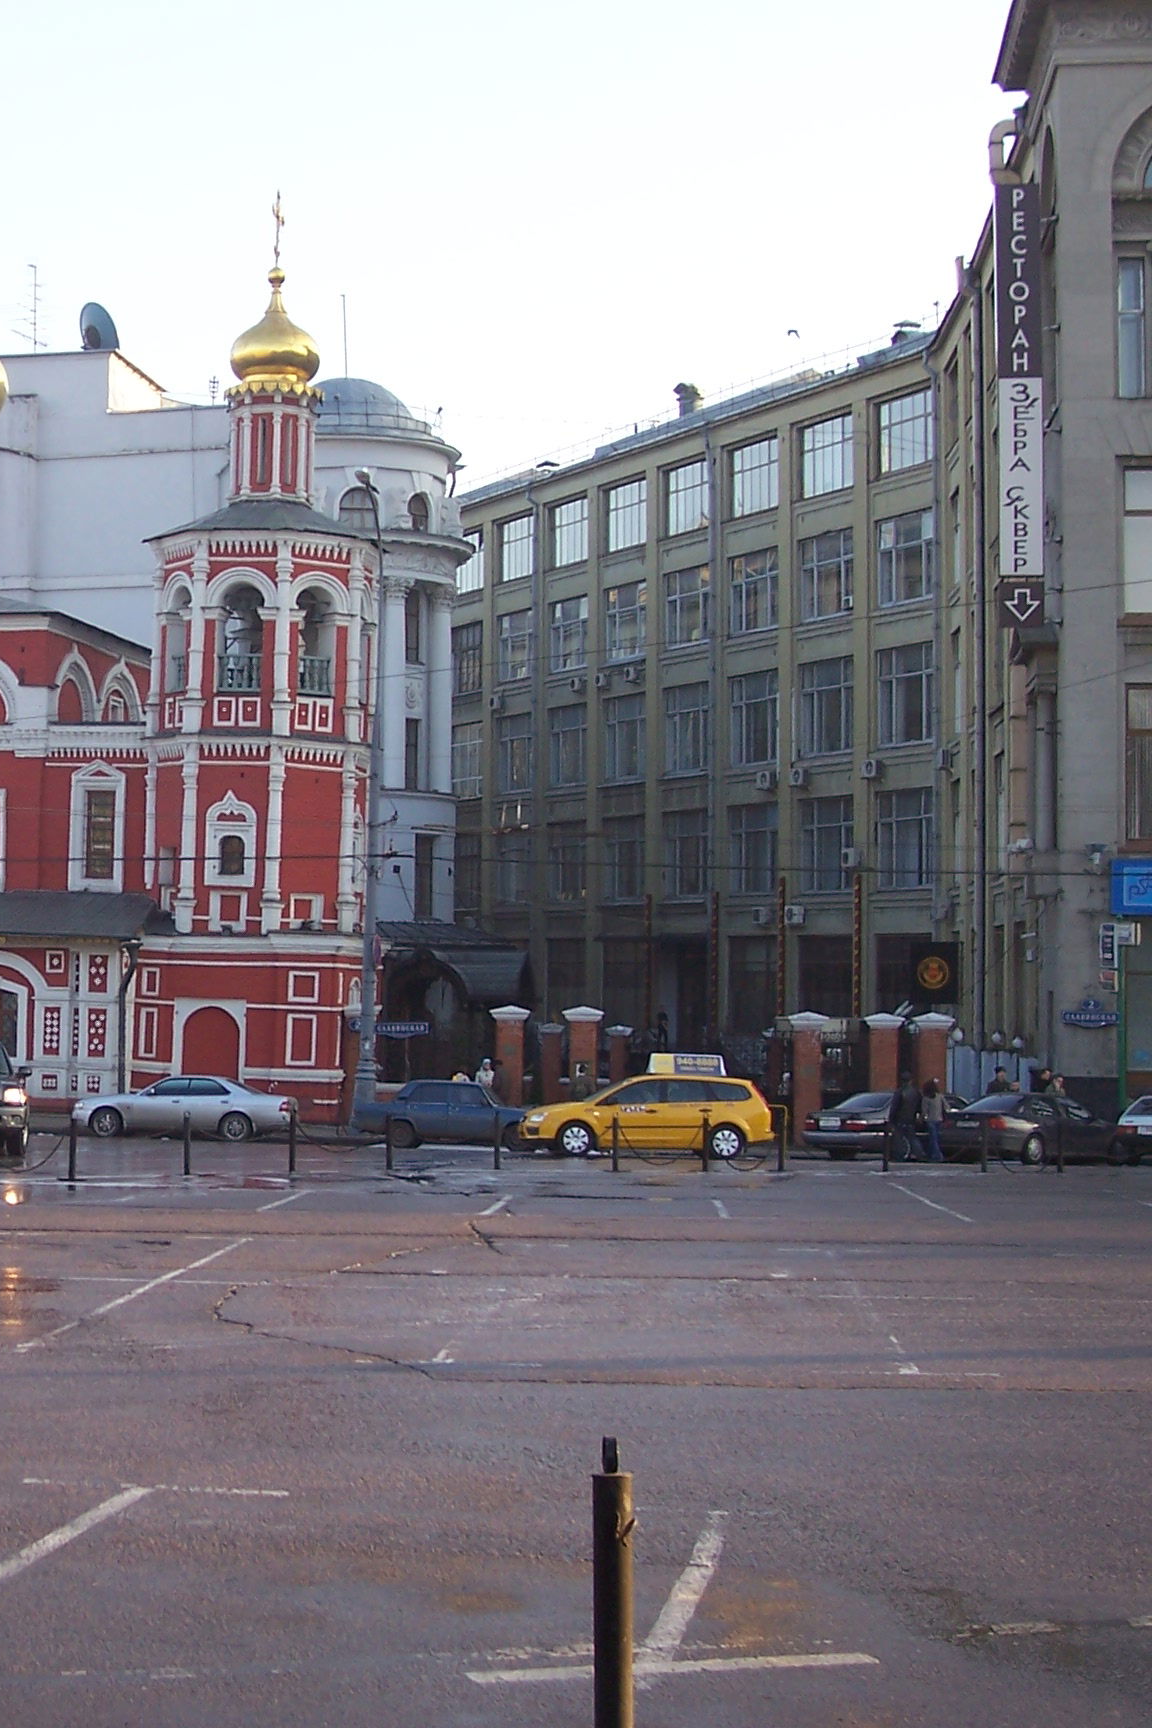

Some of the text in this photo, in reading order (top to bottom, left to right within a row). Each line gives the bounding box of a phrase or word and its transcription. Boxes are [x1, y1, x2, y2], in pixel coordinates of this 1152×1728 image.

[1009, 188, 1030, 373] РЕСТОРАН
[1009, 383, 1039, 472] ЗЕБРА
[1003, 486, 1030, 573] СКВЕР
[1088, 1000, 1095, 1009] 2
